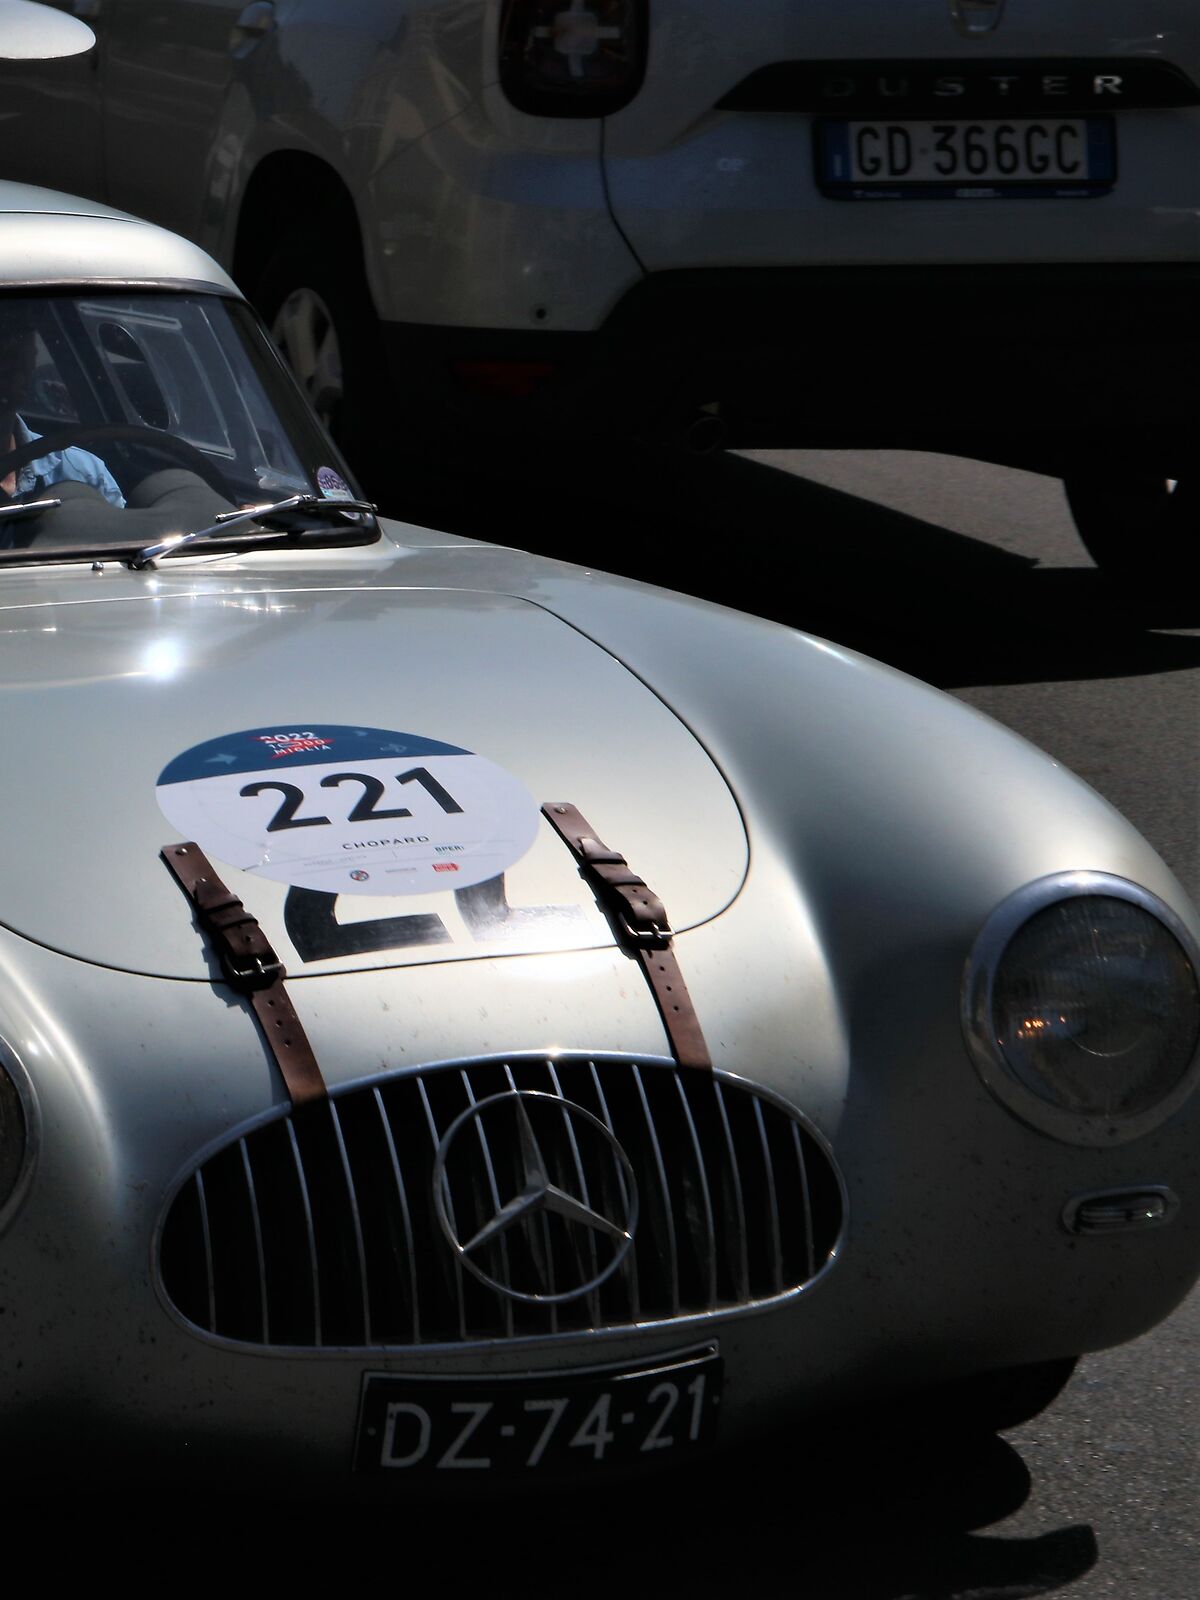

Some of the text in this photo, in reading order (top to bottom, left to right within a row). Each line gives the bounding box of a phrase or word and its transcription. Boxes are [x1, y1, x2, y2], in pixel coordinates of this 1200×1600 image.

[823, 75, 1124, 97] DUSTER
[260, 731, 319, 744] 2022
[273, 744, 332, 755] MIGLIA
[239, 766, 465, 832] 221
[341, 835, 430, 851] CHOPARD
[379, 1373, 707, 1469] DZ-74-21
